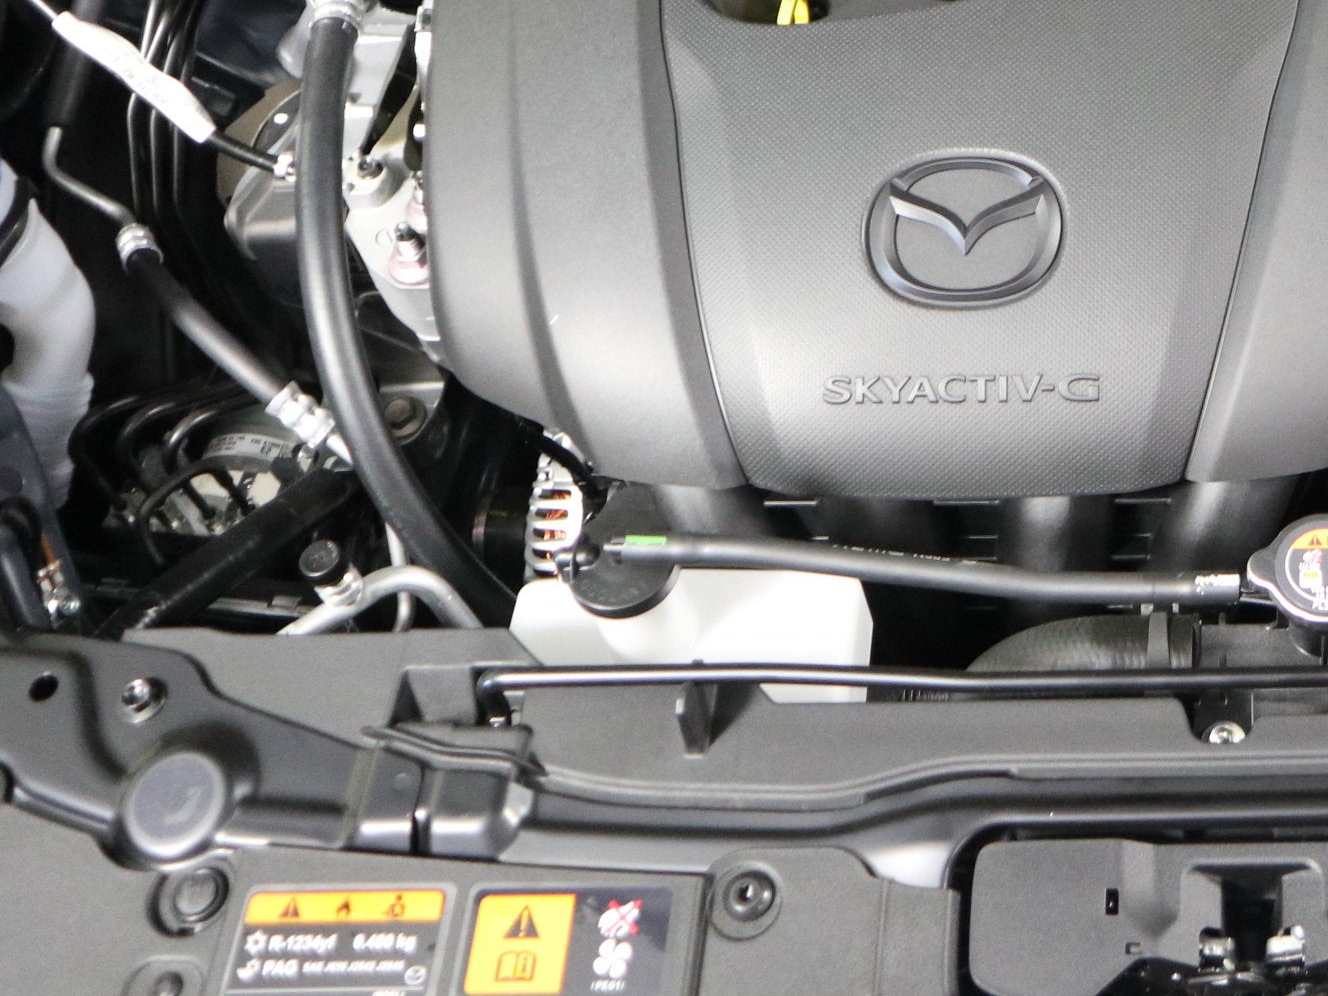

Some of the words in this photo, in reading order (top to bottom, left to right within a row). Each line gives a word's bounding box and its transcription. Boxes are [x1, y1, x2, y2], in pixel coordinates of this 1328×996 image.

[821, 373, 1100, 404] SKYACTIV-G
[268, 934, 338, 955] R-1234yf
[396, 933, 417, 955] kg
[262, 959, 299, 977] PAG
